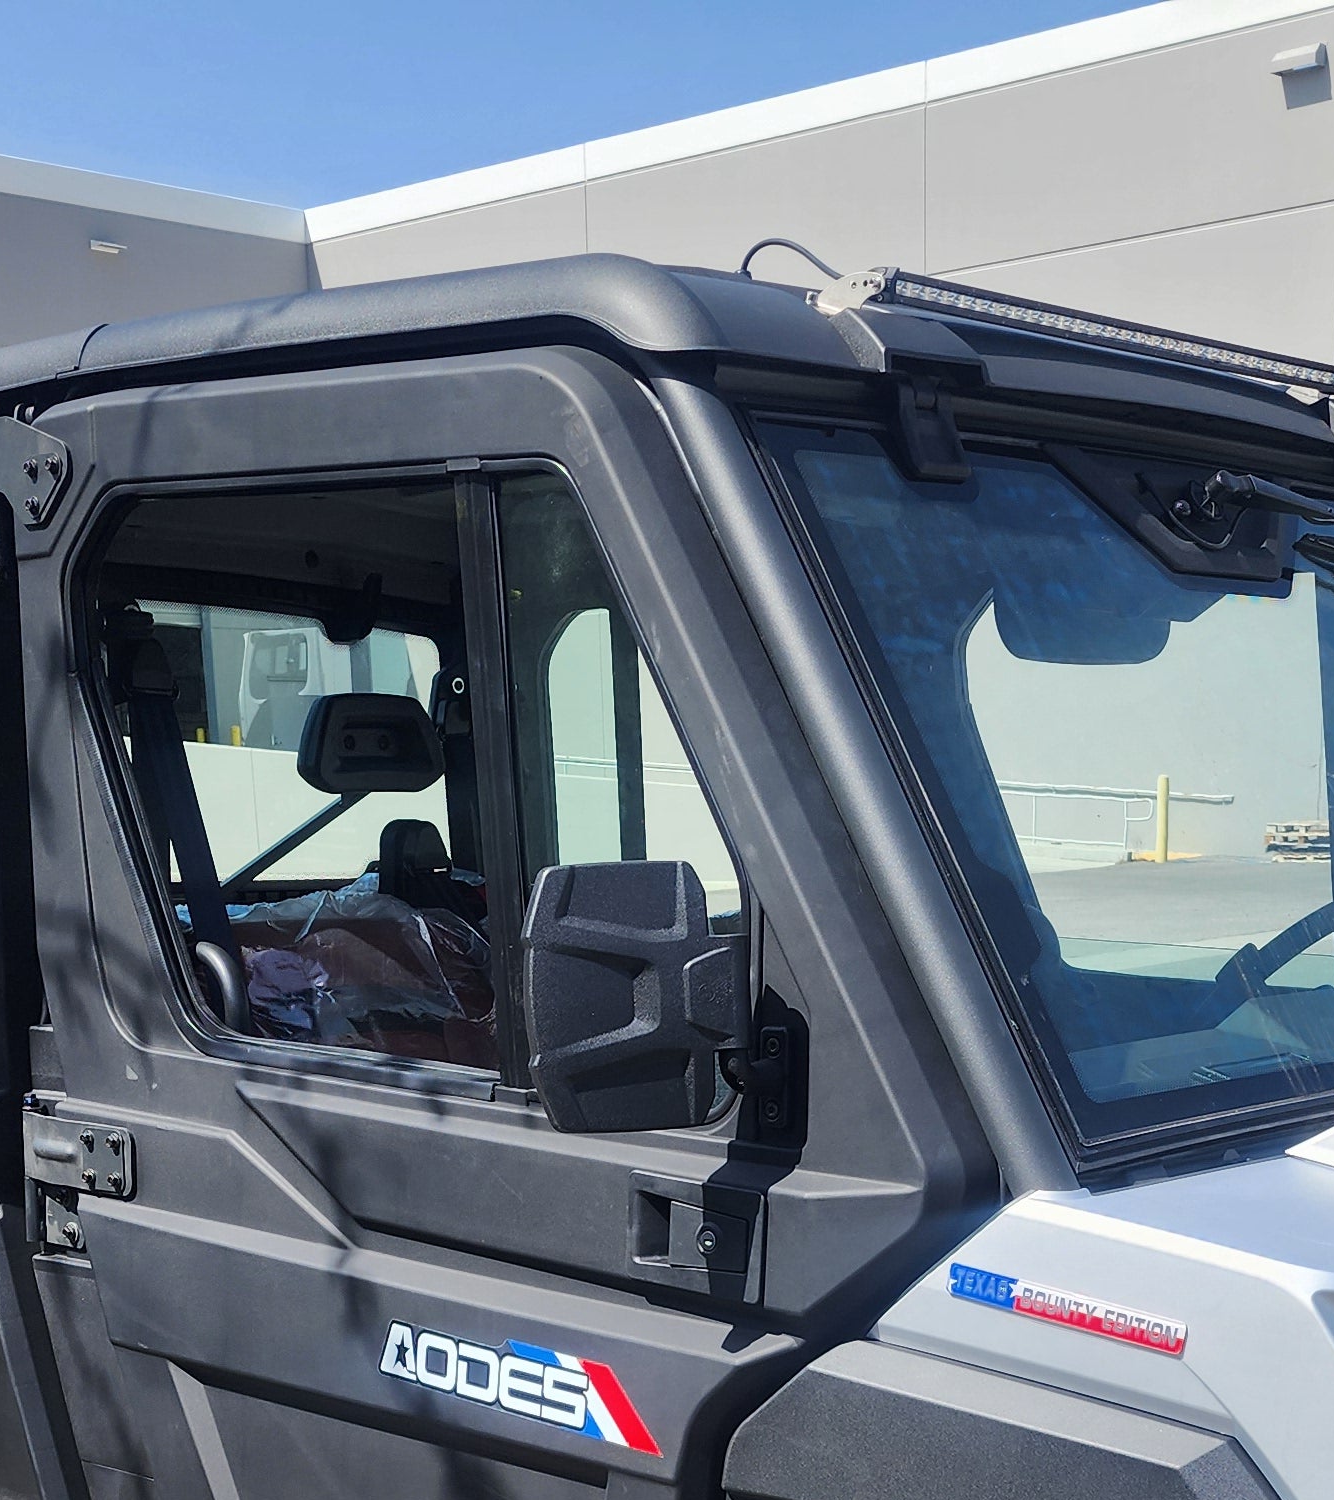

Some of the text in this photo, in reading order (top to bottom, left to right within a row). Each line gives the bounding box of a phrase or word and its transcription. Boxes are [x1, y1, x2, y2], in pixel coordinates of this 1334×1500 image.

[954, 1267, 1178, 1348] TEXAS BOUNTY EDITION
[379, 1320, 590, 1431] AODES
